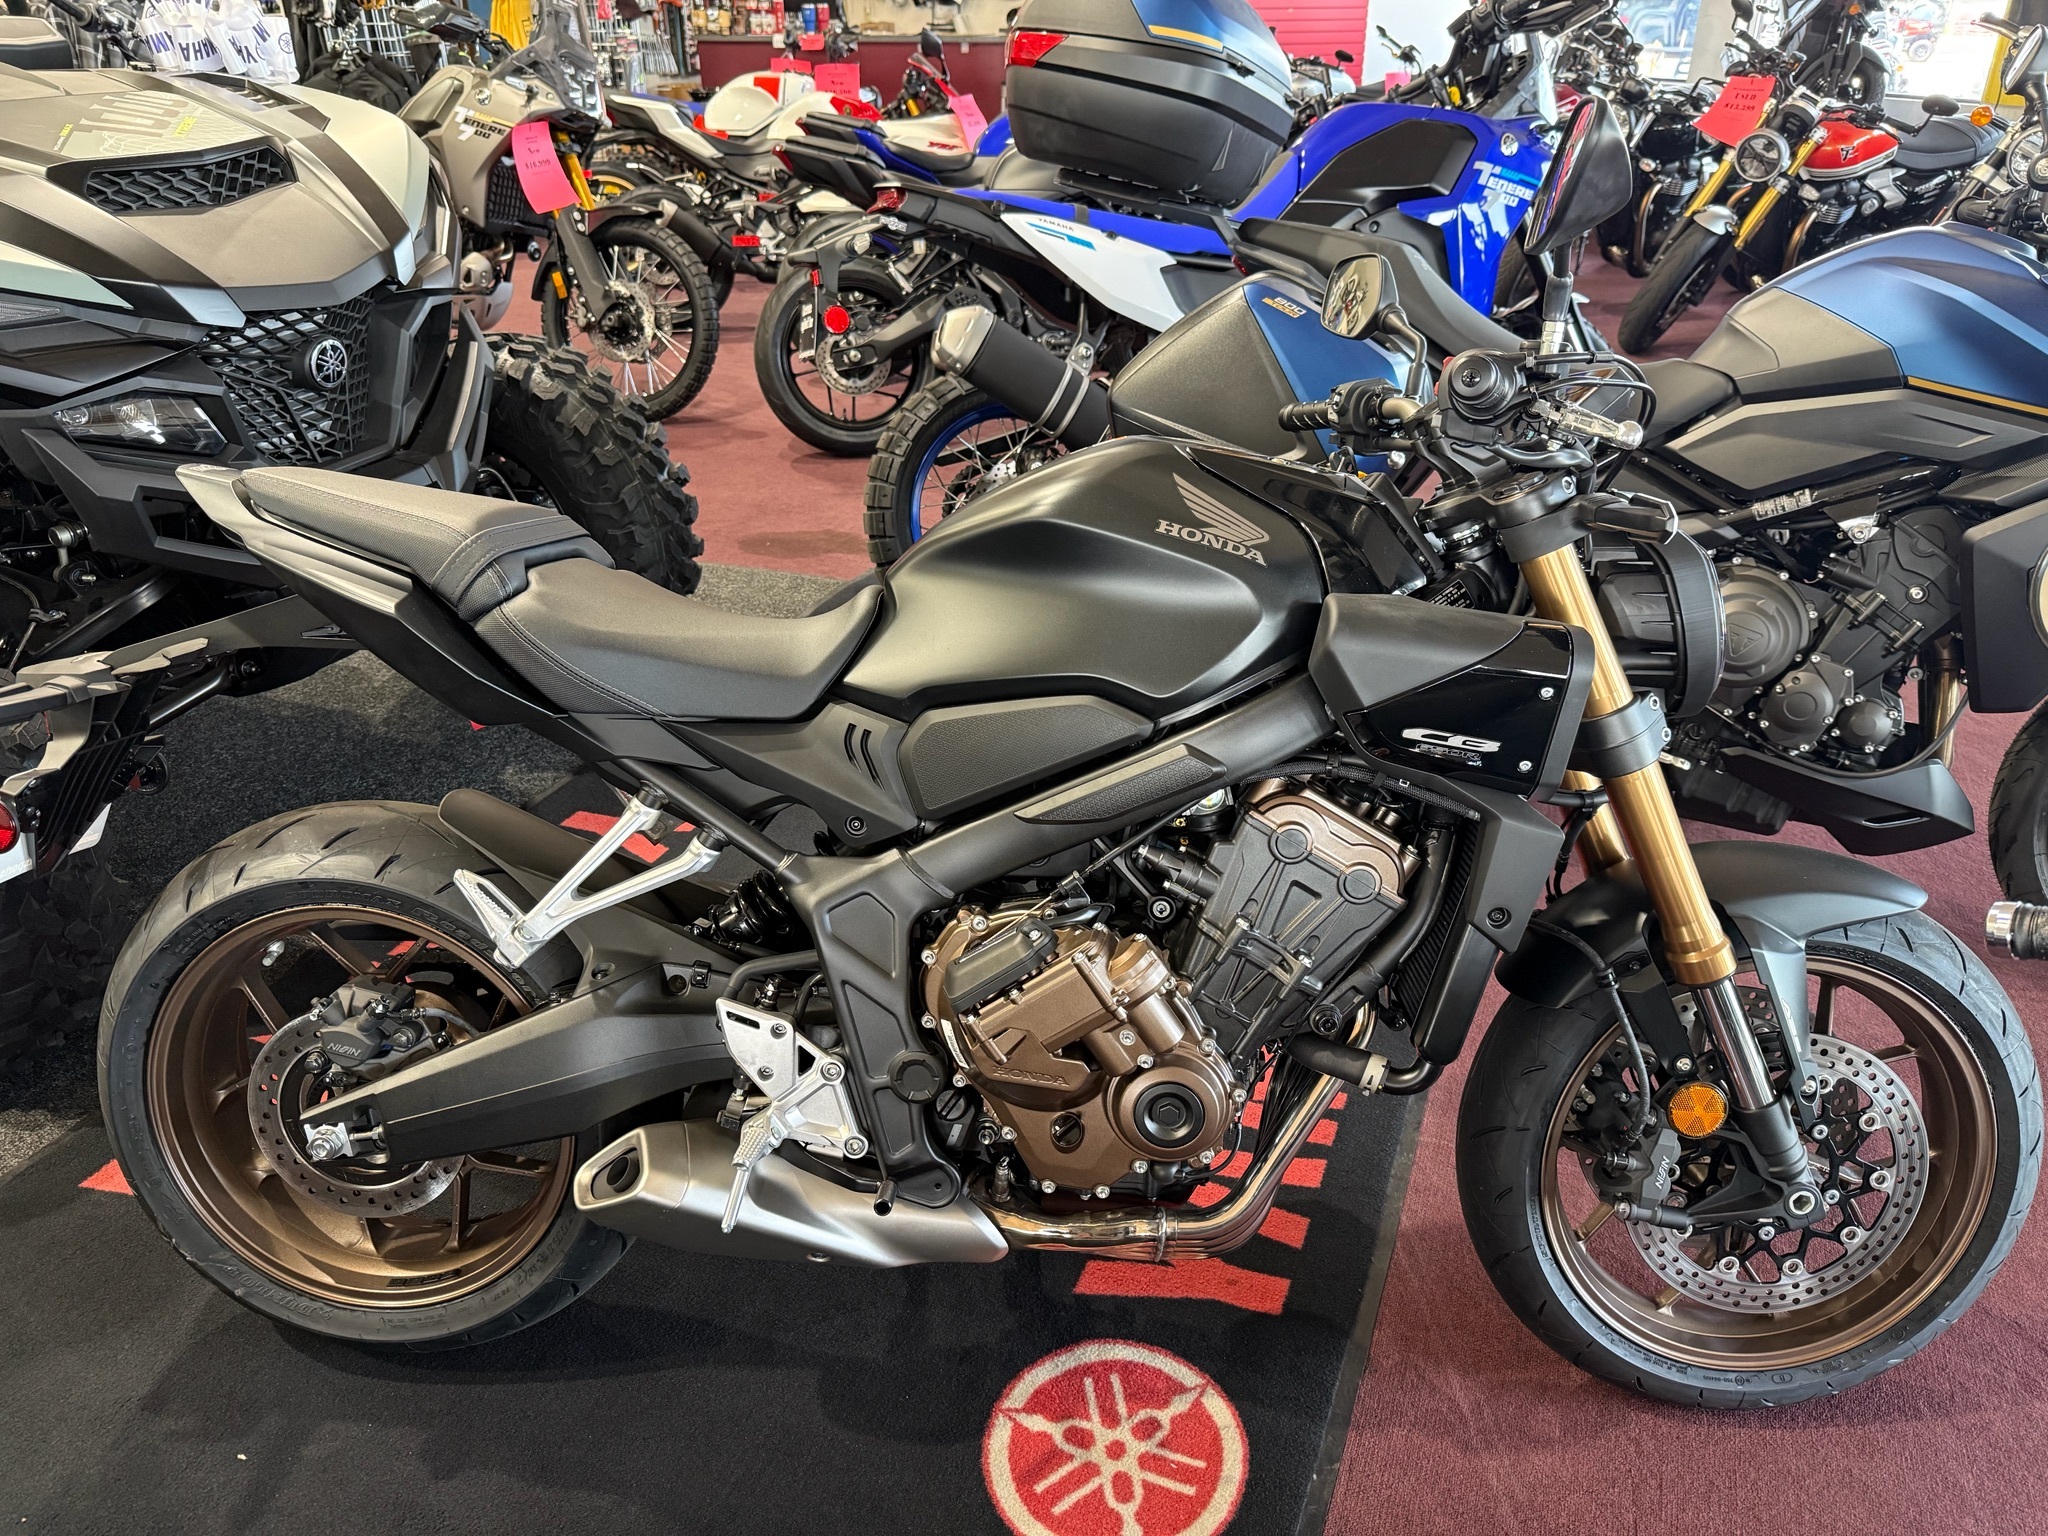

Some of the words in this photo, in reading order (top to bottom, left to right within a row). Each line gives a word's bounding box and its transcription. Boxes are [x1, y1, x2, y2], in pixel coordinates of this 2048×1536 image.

[1037, 217, 1075, 232] YAMAHA
[1273, 296, 1308, 315] 800
[1154, 519, 1268, 567] HONDA
[1401, 727, 1503, 753] CB
[992, 1065, 1071, 1088] HONDA
